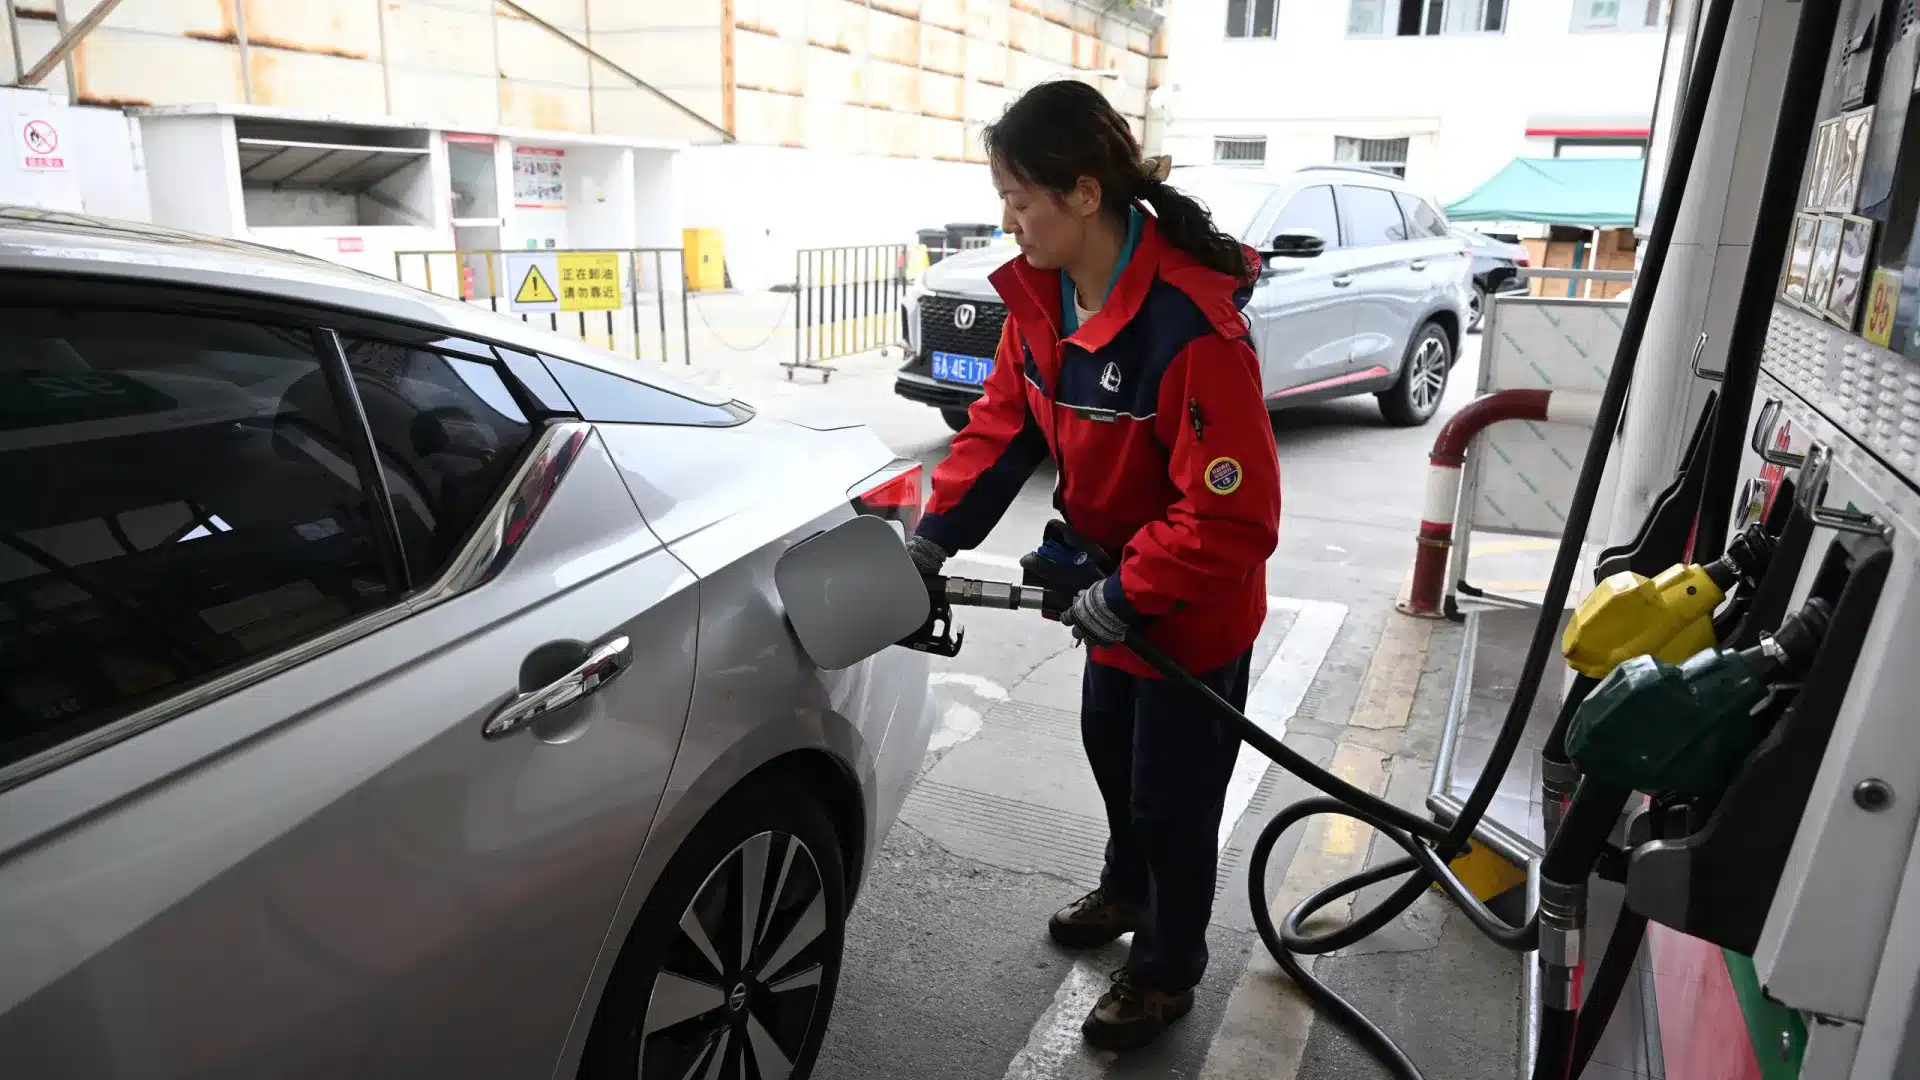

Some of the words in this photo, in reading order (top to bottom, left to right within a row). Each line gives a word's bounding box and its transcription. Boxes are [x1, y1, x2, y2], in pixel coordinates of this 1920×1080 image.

[563, 269, 613, 280] 正在卸油
[564, 287, 614, 299] 请勿靠近
[1870, 283, 1897, 334] 95
